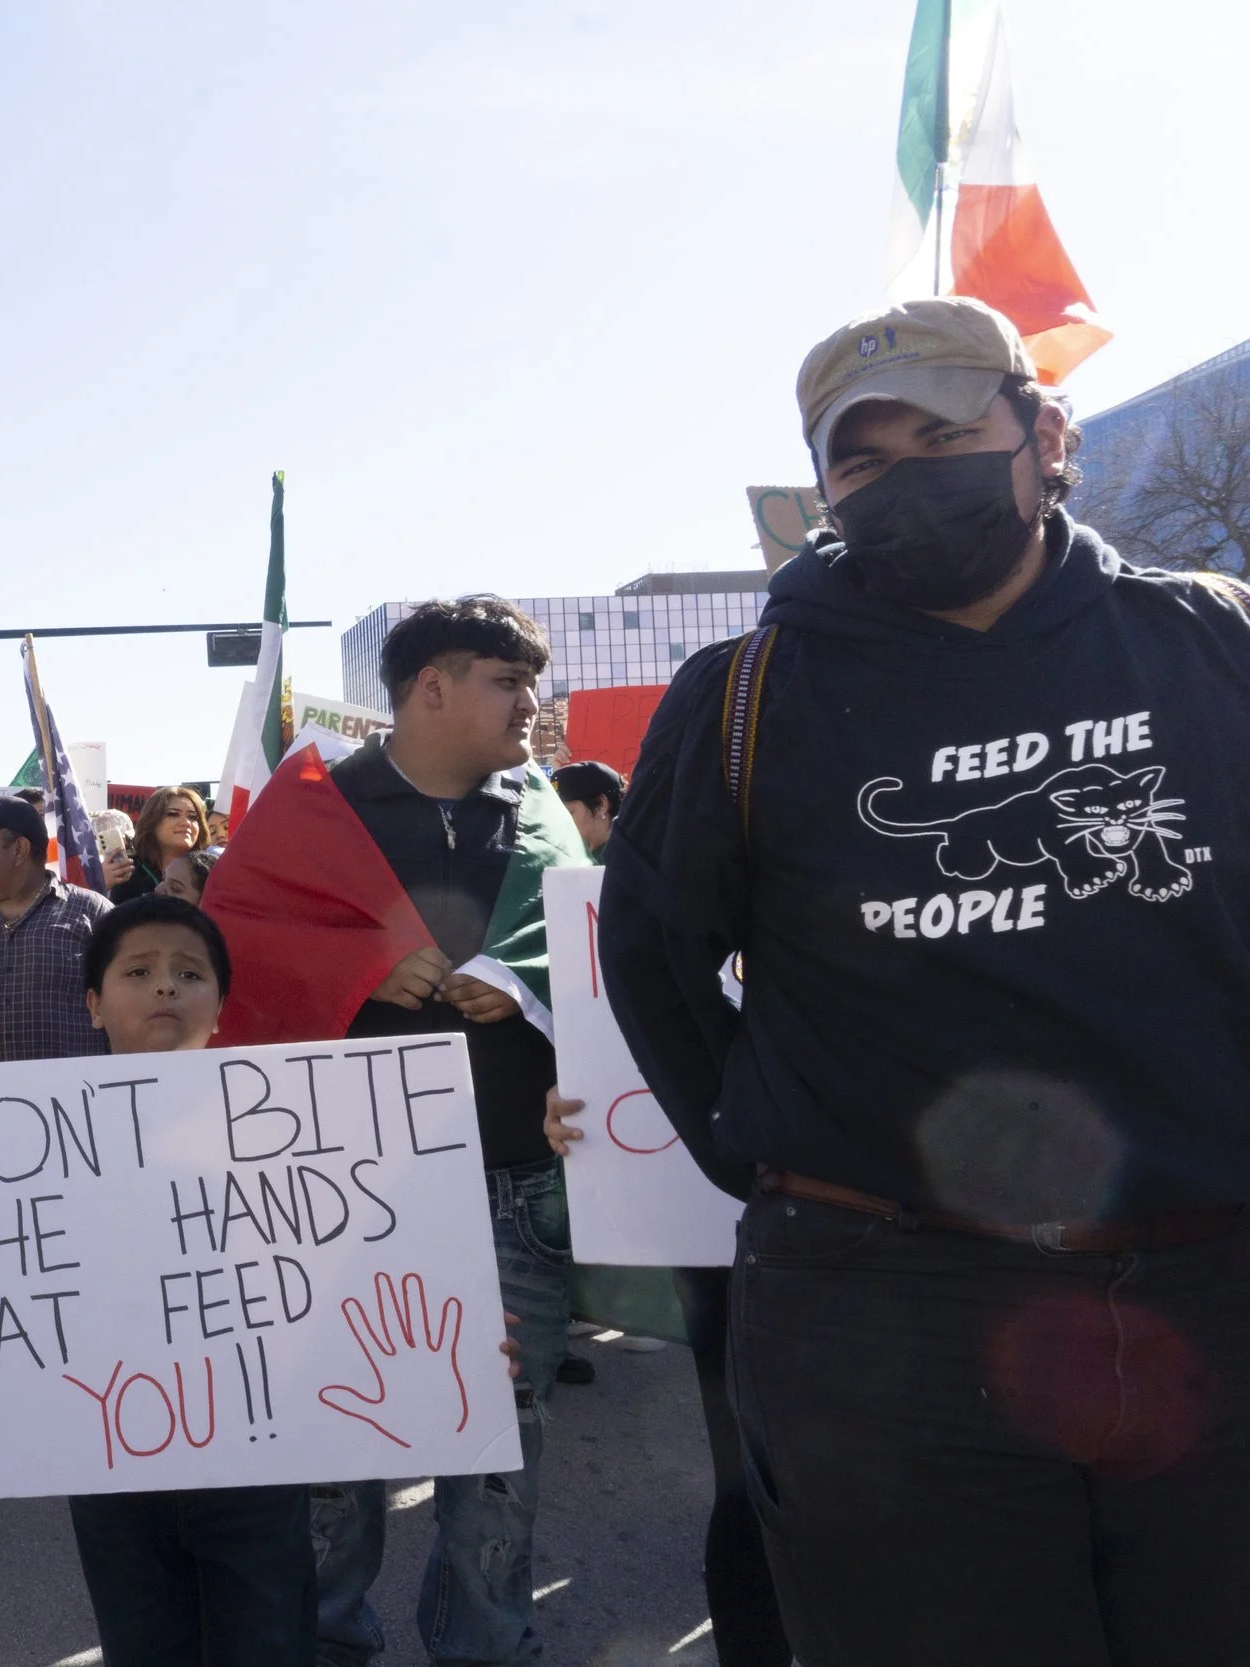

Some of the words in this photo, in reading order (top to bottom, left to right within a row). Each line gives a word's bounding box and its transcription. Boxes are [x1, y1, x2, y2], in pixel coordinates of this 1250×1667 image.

[860, 337, 877, 357] hp
[300, 706, 393, 739] PAREN
[931, 731, 1050, 783] FEED
[1064, 711, 1153, 763] THE
[1184, 846, 1213, 864] DTX
[860, 883, 1048, 939] PEOPLE
[219, 1040, 467, 1163] BITE
[170, 1159, 397, 1255] HANDS
[159, 1254, 313, 1345] FEED
[62, 1335, 278, 1470] YOU!!
